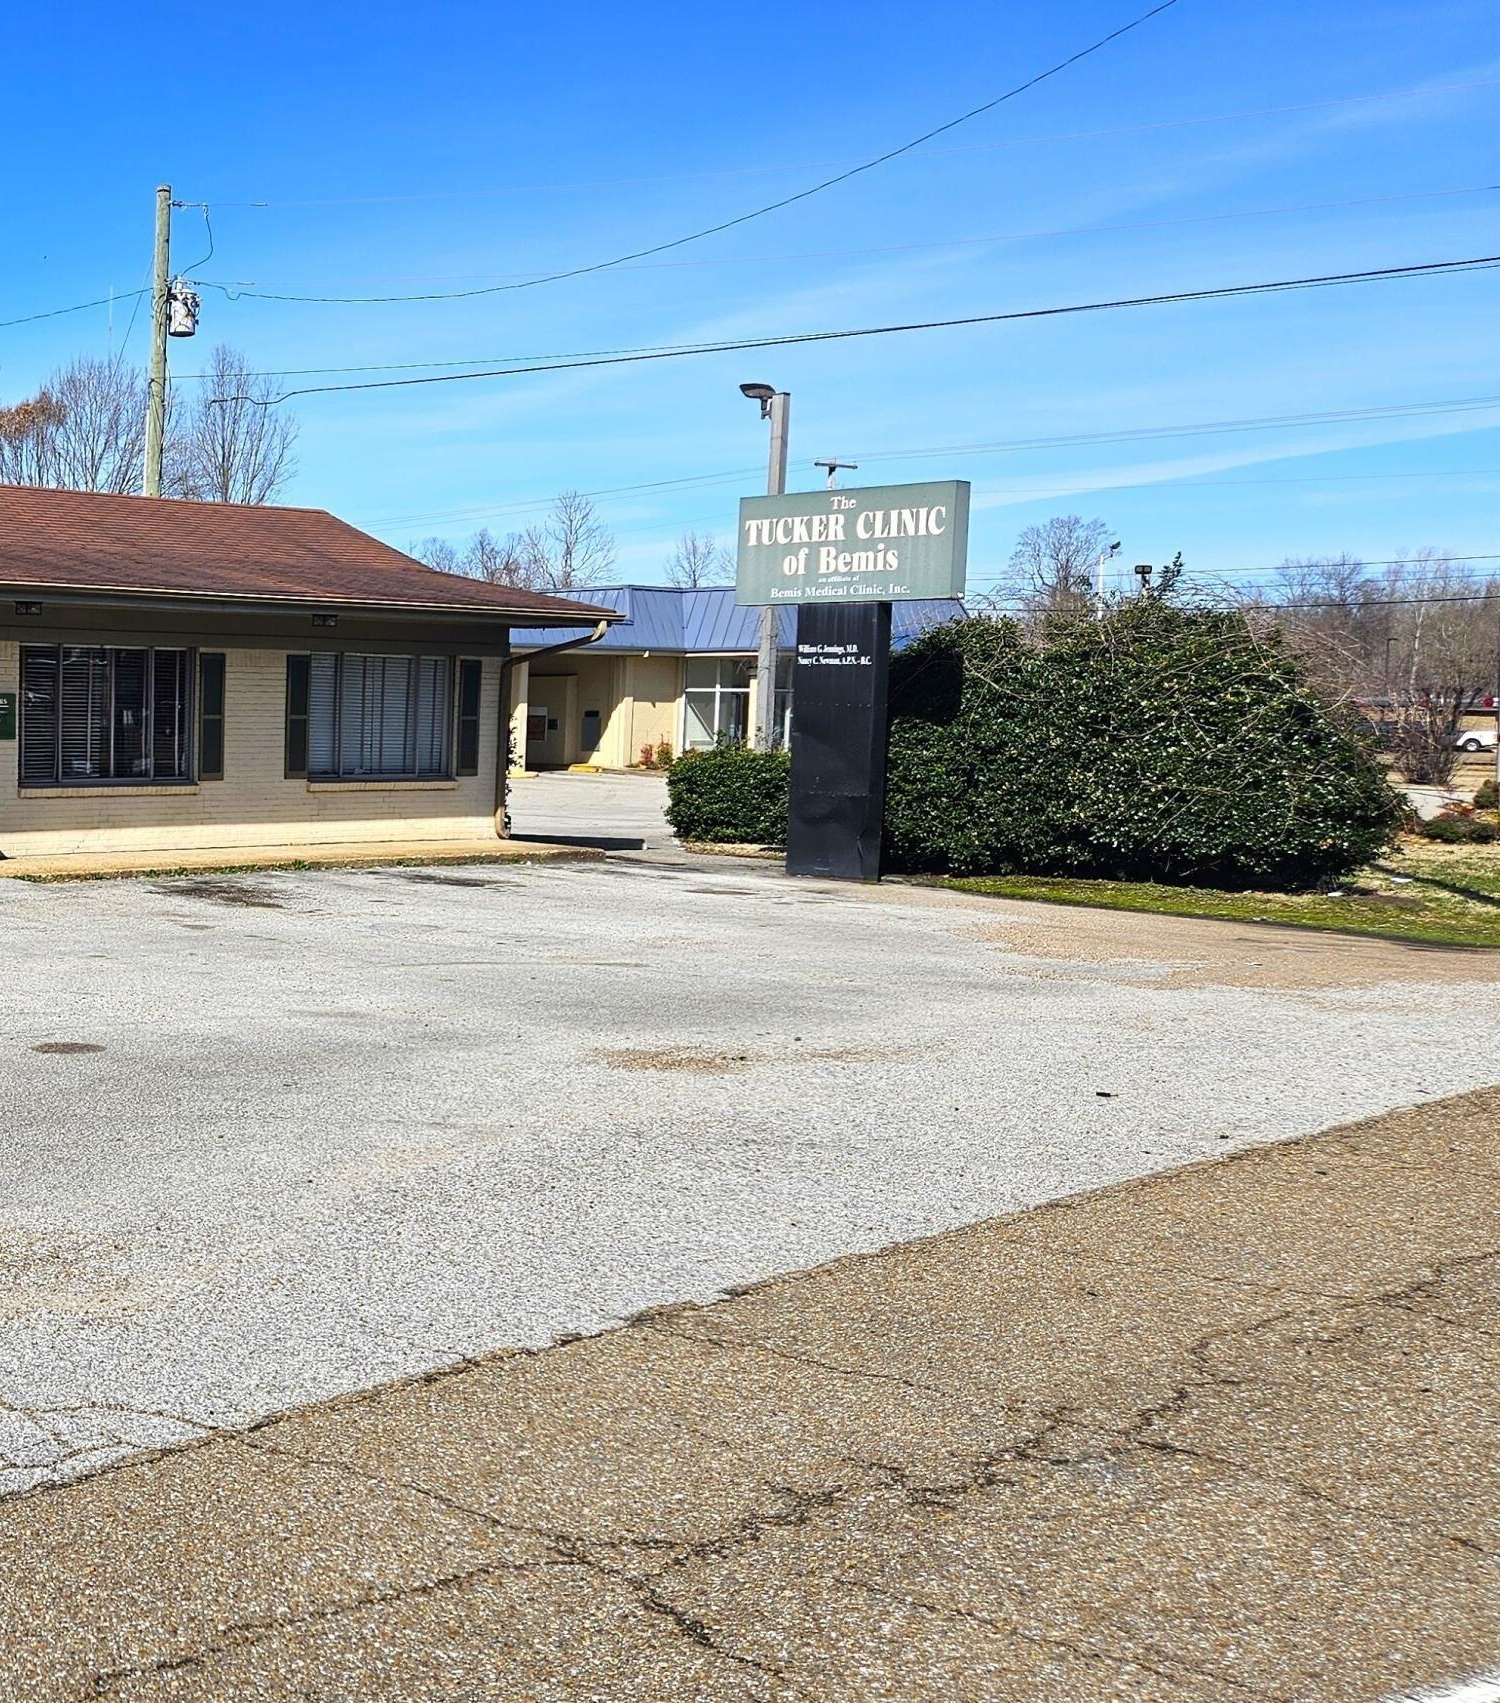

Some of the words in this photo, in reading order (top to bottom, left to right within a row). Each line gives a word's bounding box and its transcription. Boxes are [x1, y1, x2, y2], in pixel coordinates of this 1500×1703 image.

[830, 496, 857, 510] The
[745, 513, 846, 546] TUCKER
[856, 506, 946, 540] CLINIC
[783, 547, 809, 576] of
[818, 543, 899, 574] Bemis
[771, 587, 802, 599] Bemis
[804, 585, 847, 597] Medical
[850, 583, 885, 596] Clinic,
[889, 583, 910, 594] Inc.
[798, 644, 817, 653] William
